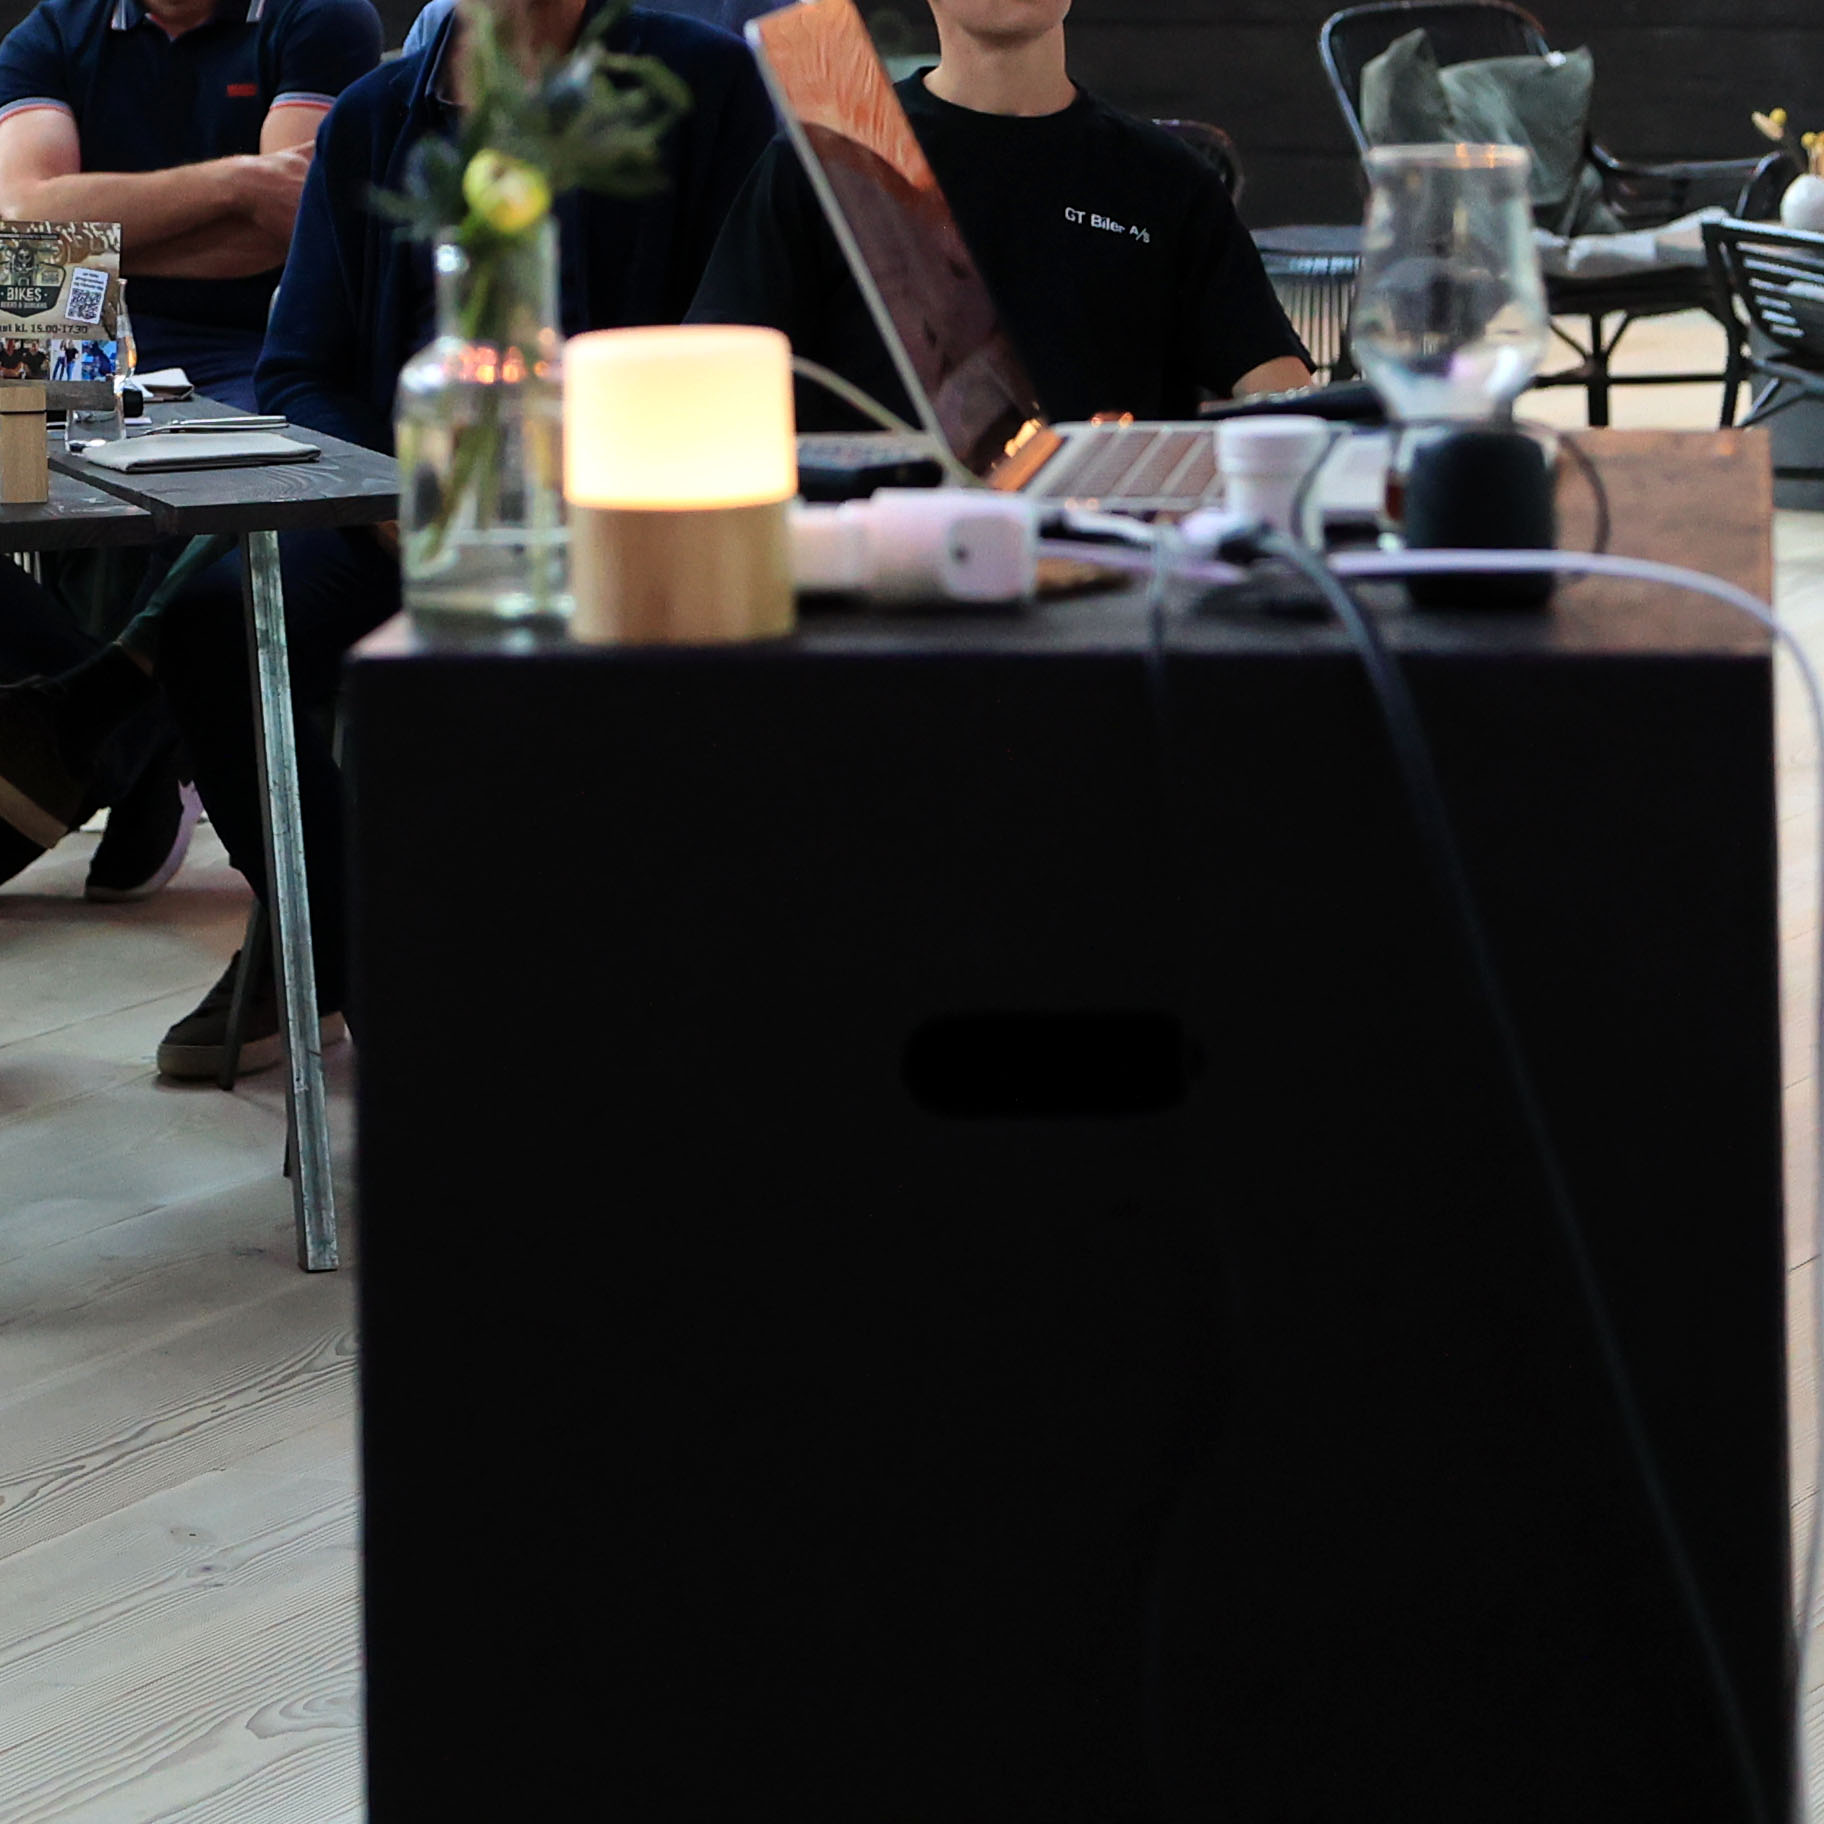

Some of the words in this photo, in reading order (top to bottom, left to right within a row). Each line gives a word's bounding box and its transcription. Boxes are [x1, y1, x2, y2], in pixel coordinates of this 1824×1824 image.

[1065, 207, 1086, 224] GT
[1091, 213, 1125, 233] Biler
[1129, 225, 1150, 244] A/S
[6, 286, 42, 302] BIKES
[15, 323, 28, 333] kl.
